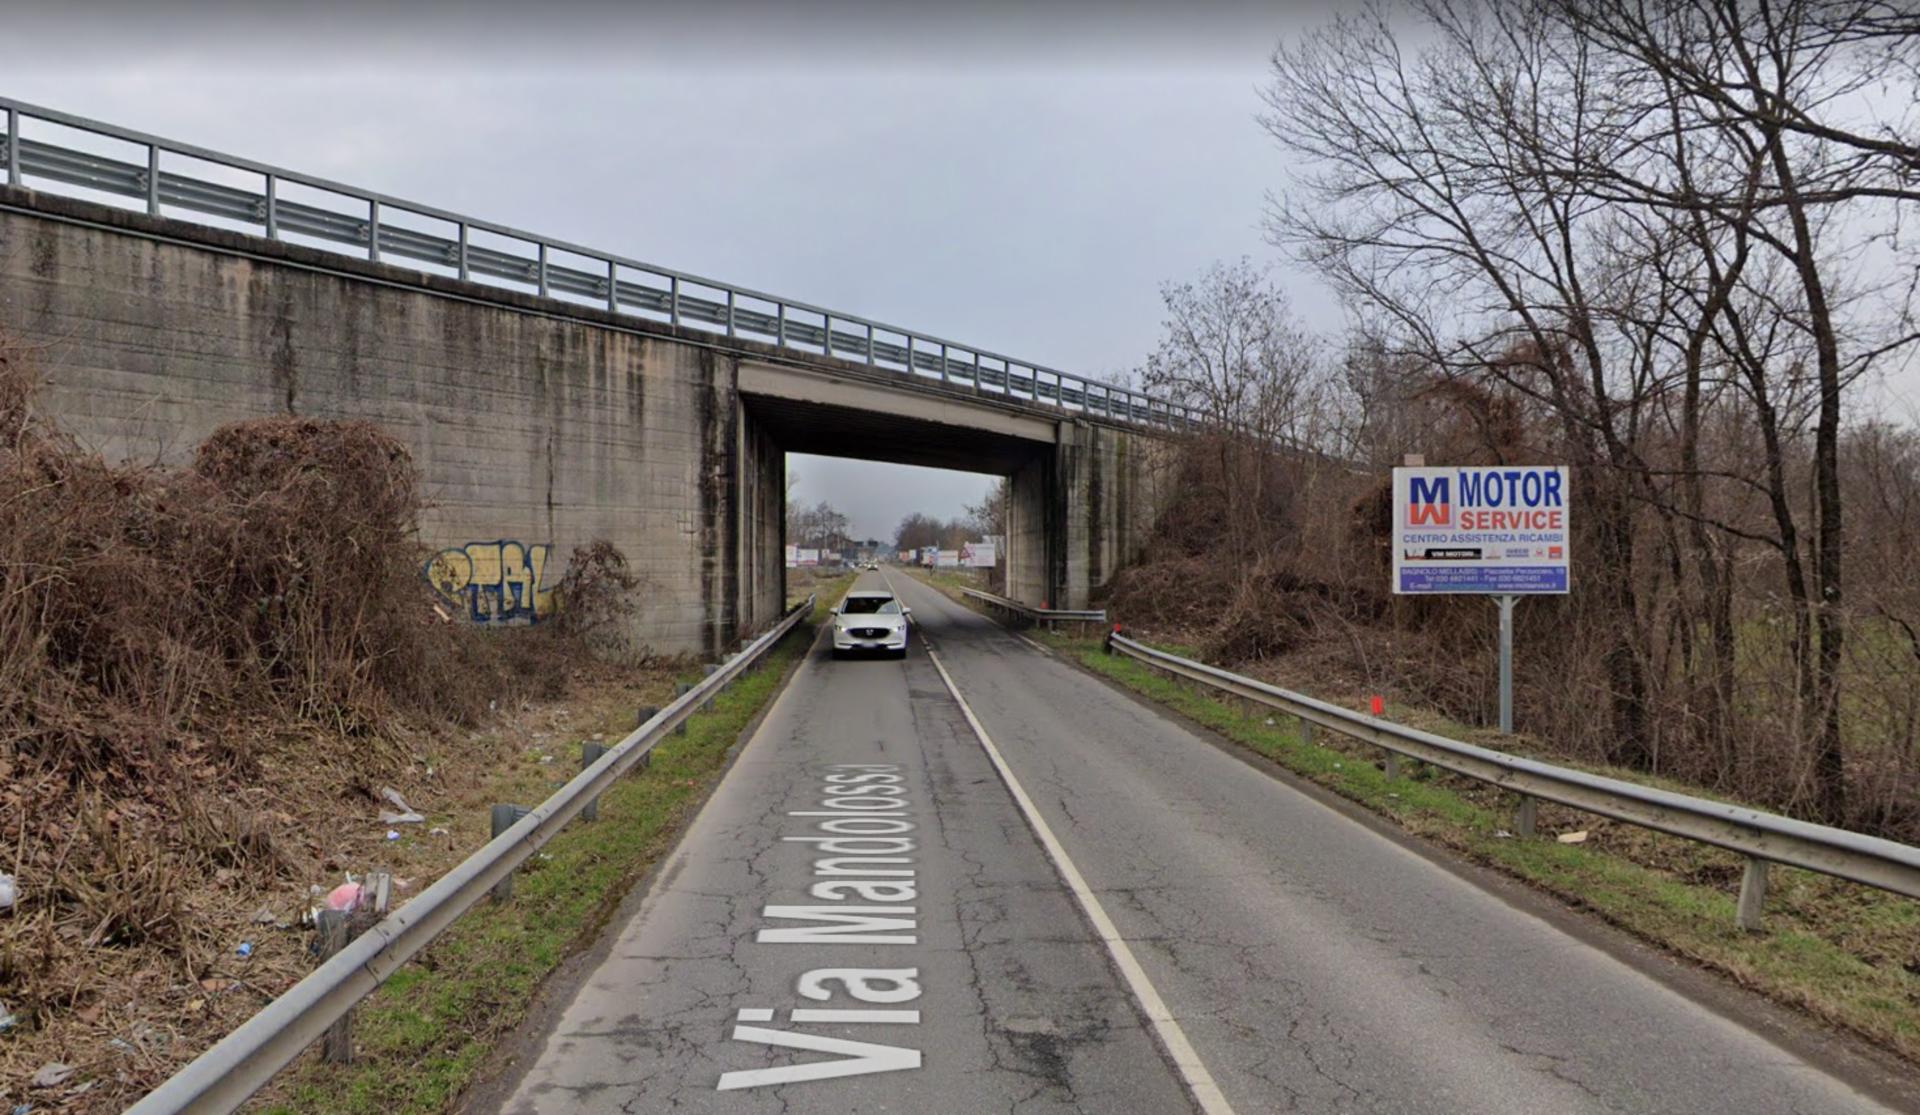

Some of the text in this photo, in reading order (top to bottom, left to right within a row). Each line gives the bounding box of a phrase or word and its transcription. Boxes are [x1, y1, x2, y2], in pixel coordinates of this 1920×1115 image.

[1459, 471, 1563, 508] MOTOR
[1460, 510, 1563, 530] SERVICE
[1402, 533, 1563, 544] CENTRO ASSISTENZA RICAMBI
